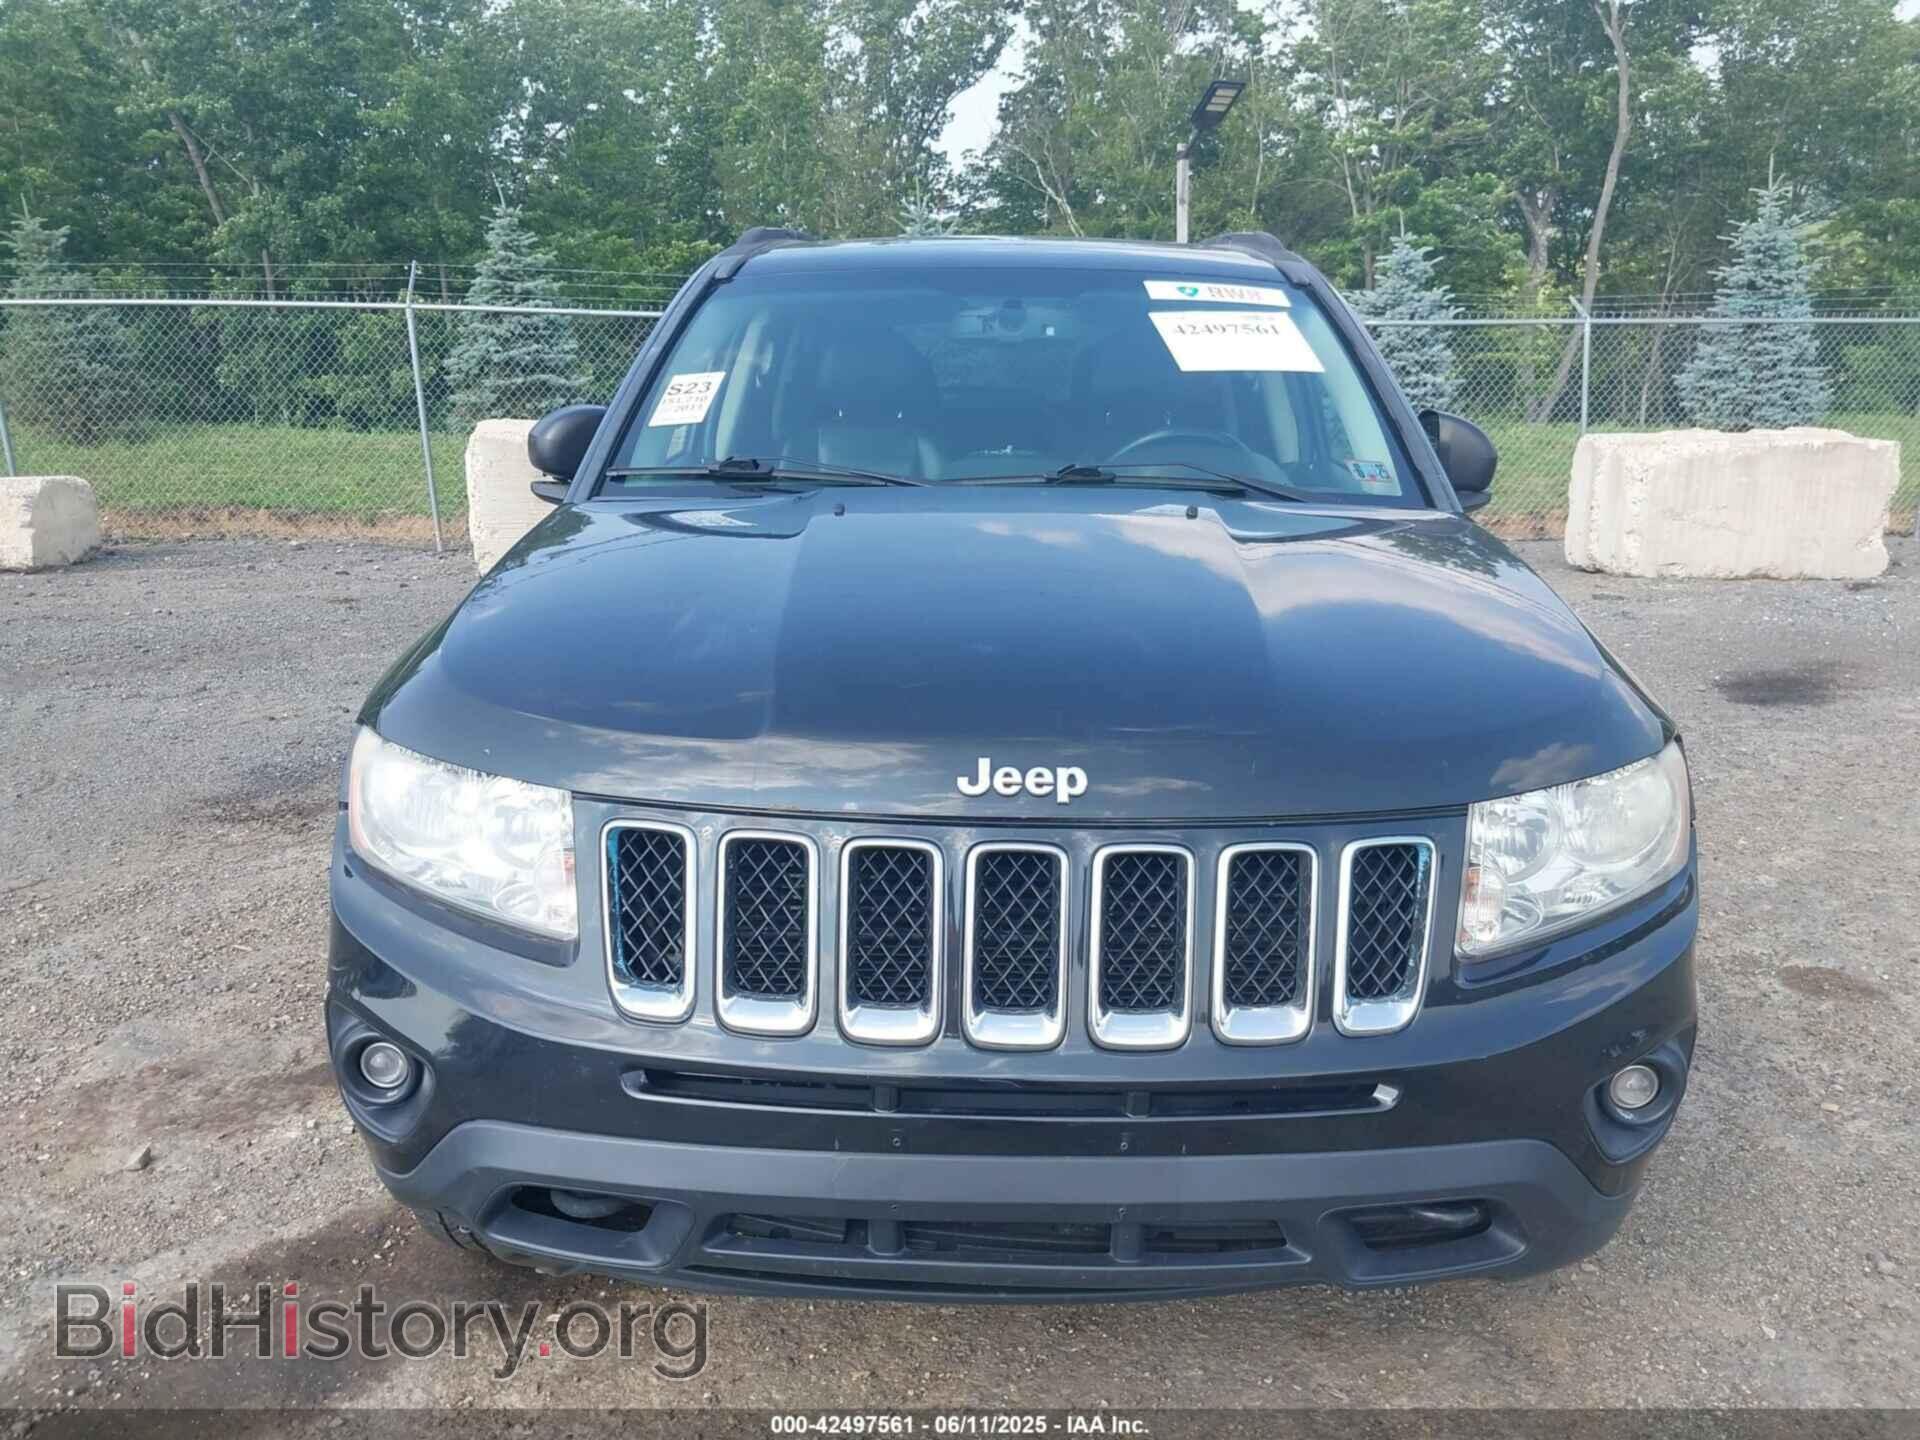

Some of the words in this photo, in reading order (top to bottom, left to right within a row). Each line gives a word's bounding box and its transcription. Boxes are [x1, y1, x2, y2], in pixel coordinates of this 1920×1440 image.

[1173, 323, 1280, 336] 42497561
[667, 381, 712, 396] S23
[956, 757, 1089, 804] Jeep
